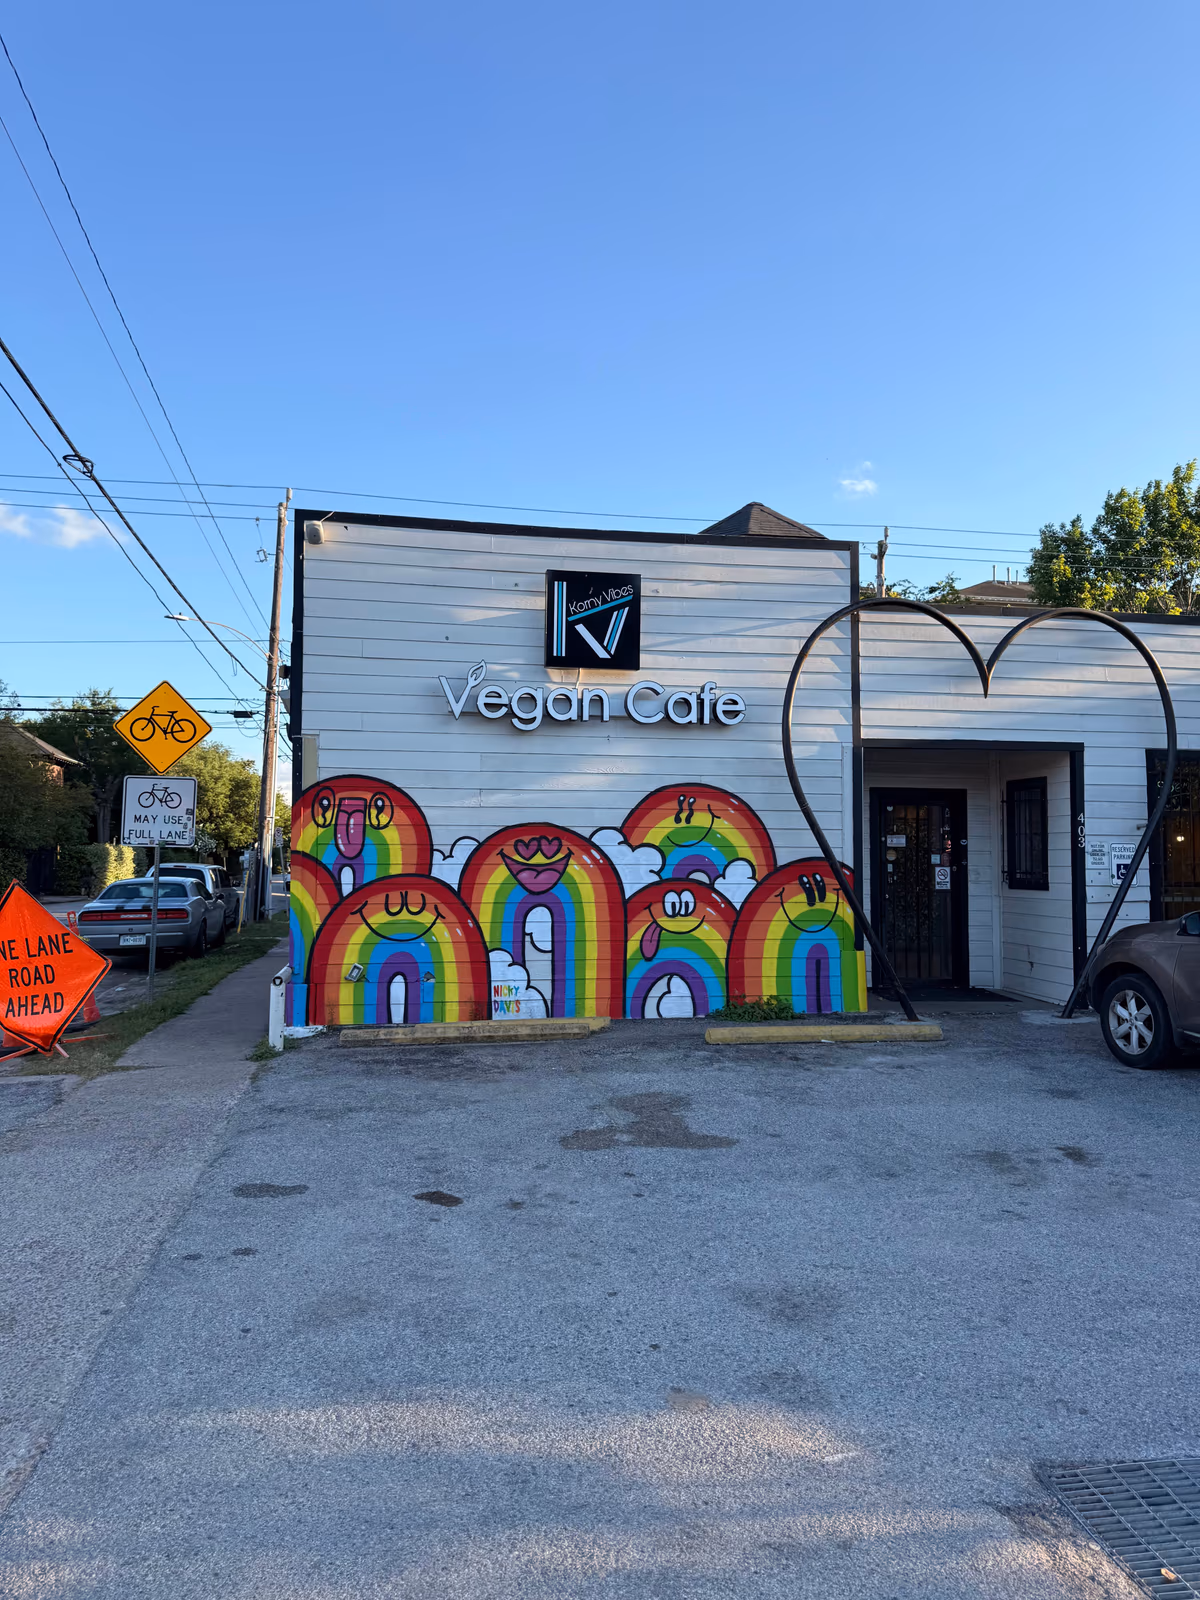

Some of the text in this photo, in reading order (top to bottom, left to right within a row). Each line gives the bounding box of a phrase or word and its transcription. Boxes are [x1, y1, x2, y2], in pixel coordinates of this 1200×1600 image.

[568, 584, 634, 615] Korny Vibes
[438, 660, 747, 730] Vegan Cafe
[133, 814, 184, 825] MAY USE
[128, 829, 188, 840] FULL LANE
[0, 932, 74, 961] NE LANE
[9, 964, 55, 988] ROAD
[5, 992, 65, 1019] AHEAD
[493, 999, 521, 1014] DAVIS
